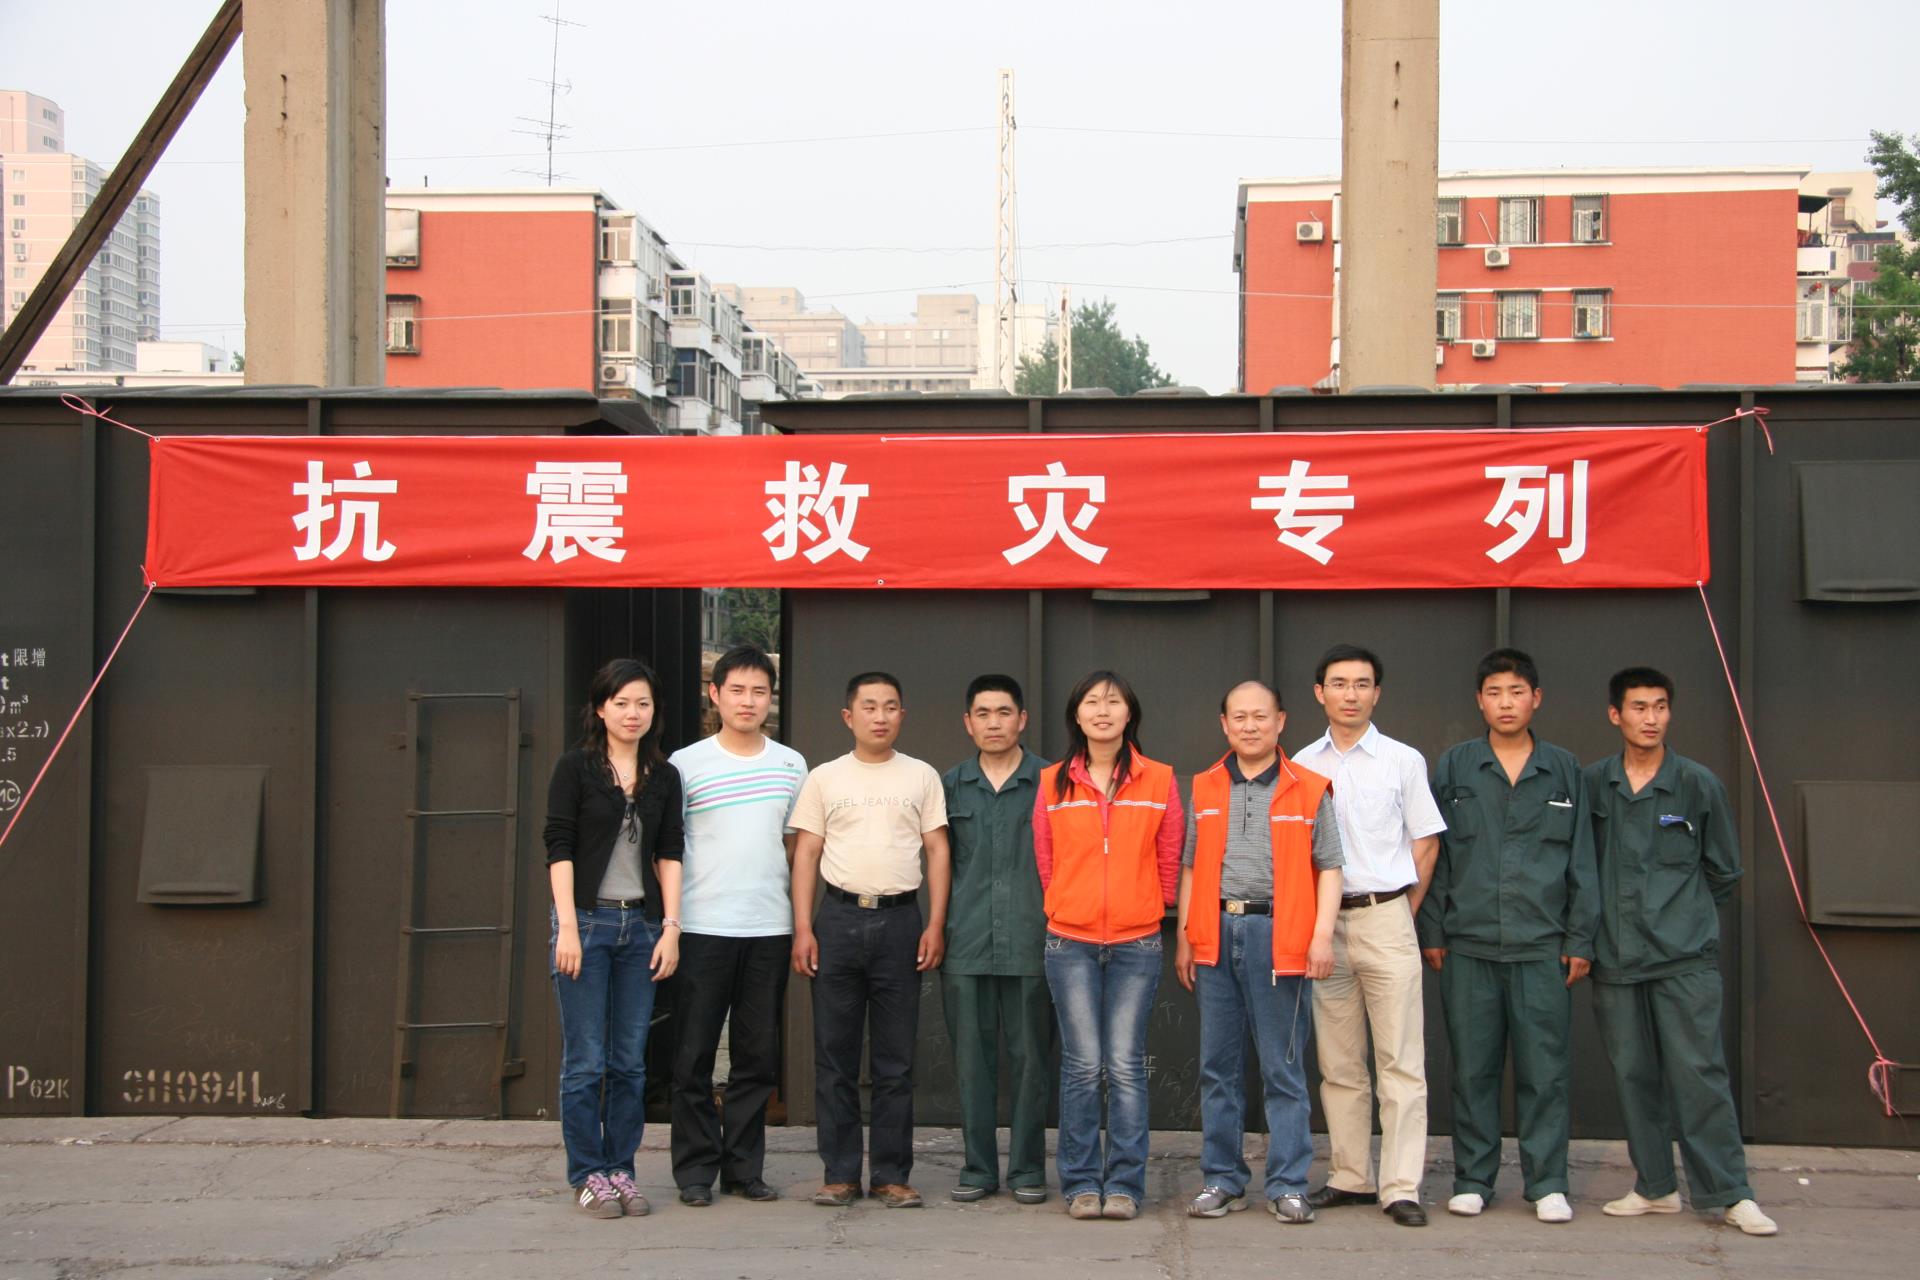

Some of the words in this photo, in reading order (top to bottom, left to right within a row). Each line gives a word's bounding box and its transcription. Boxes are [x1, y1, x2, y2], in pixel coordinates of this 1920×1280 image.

[291, 459, 1591, 566] 抗震救灾专列
[861, 795, 900, 807] JEANS
